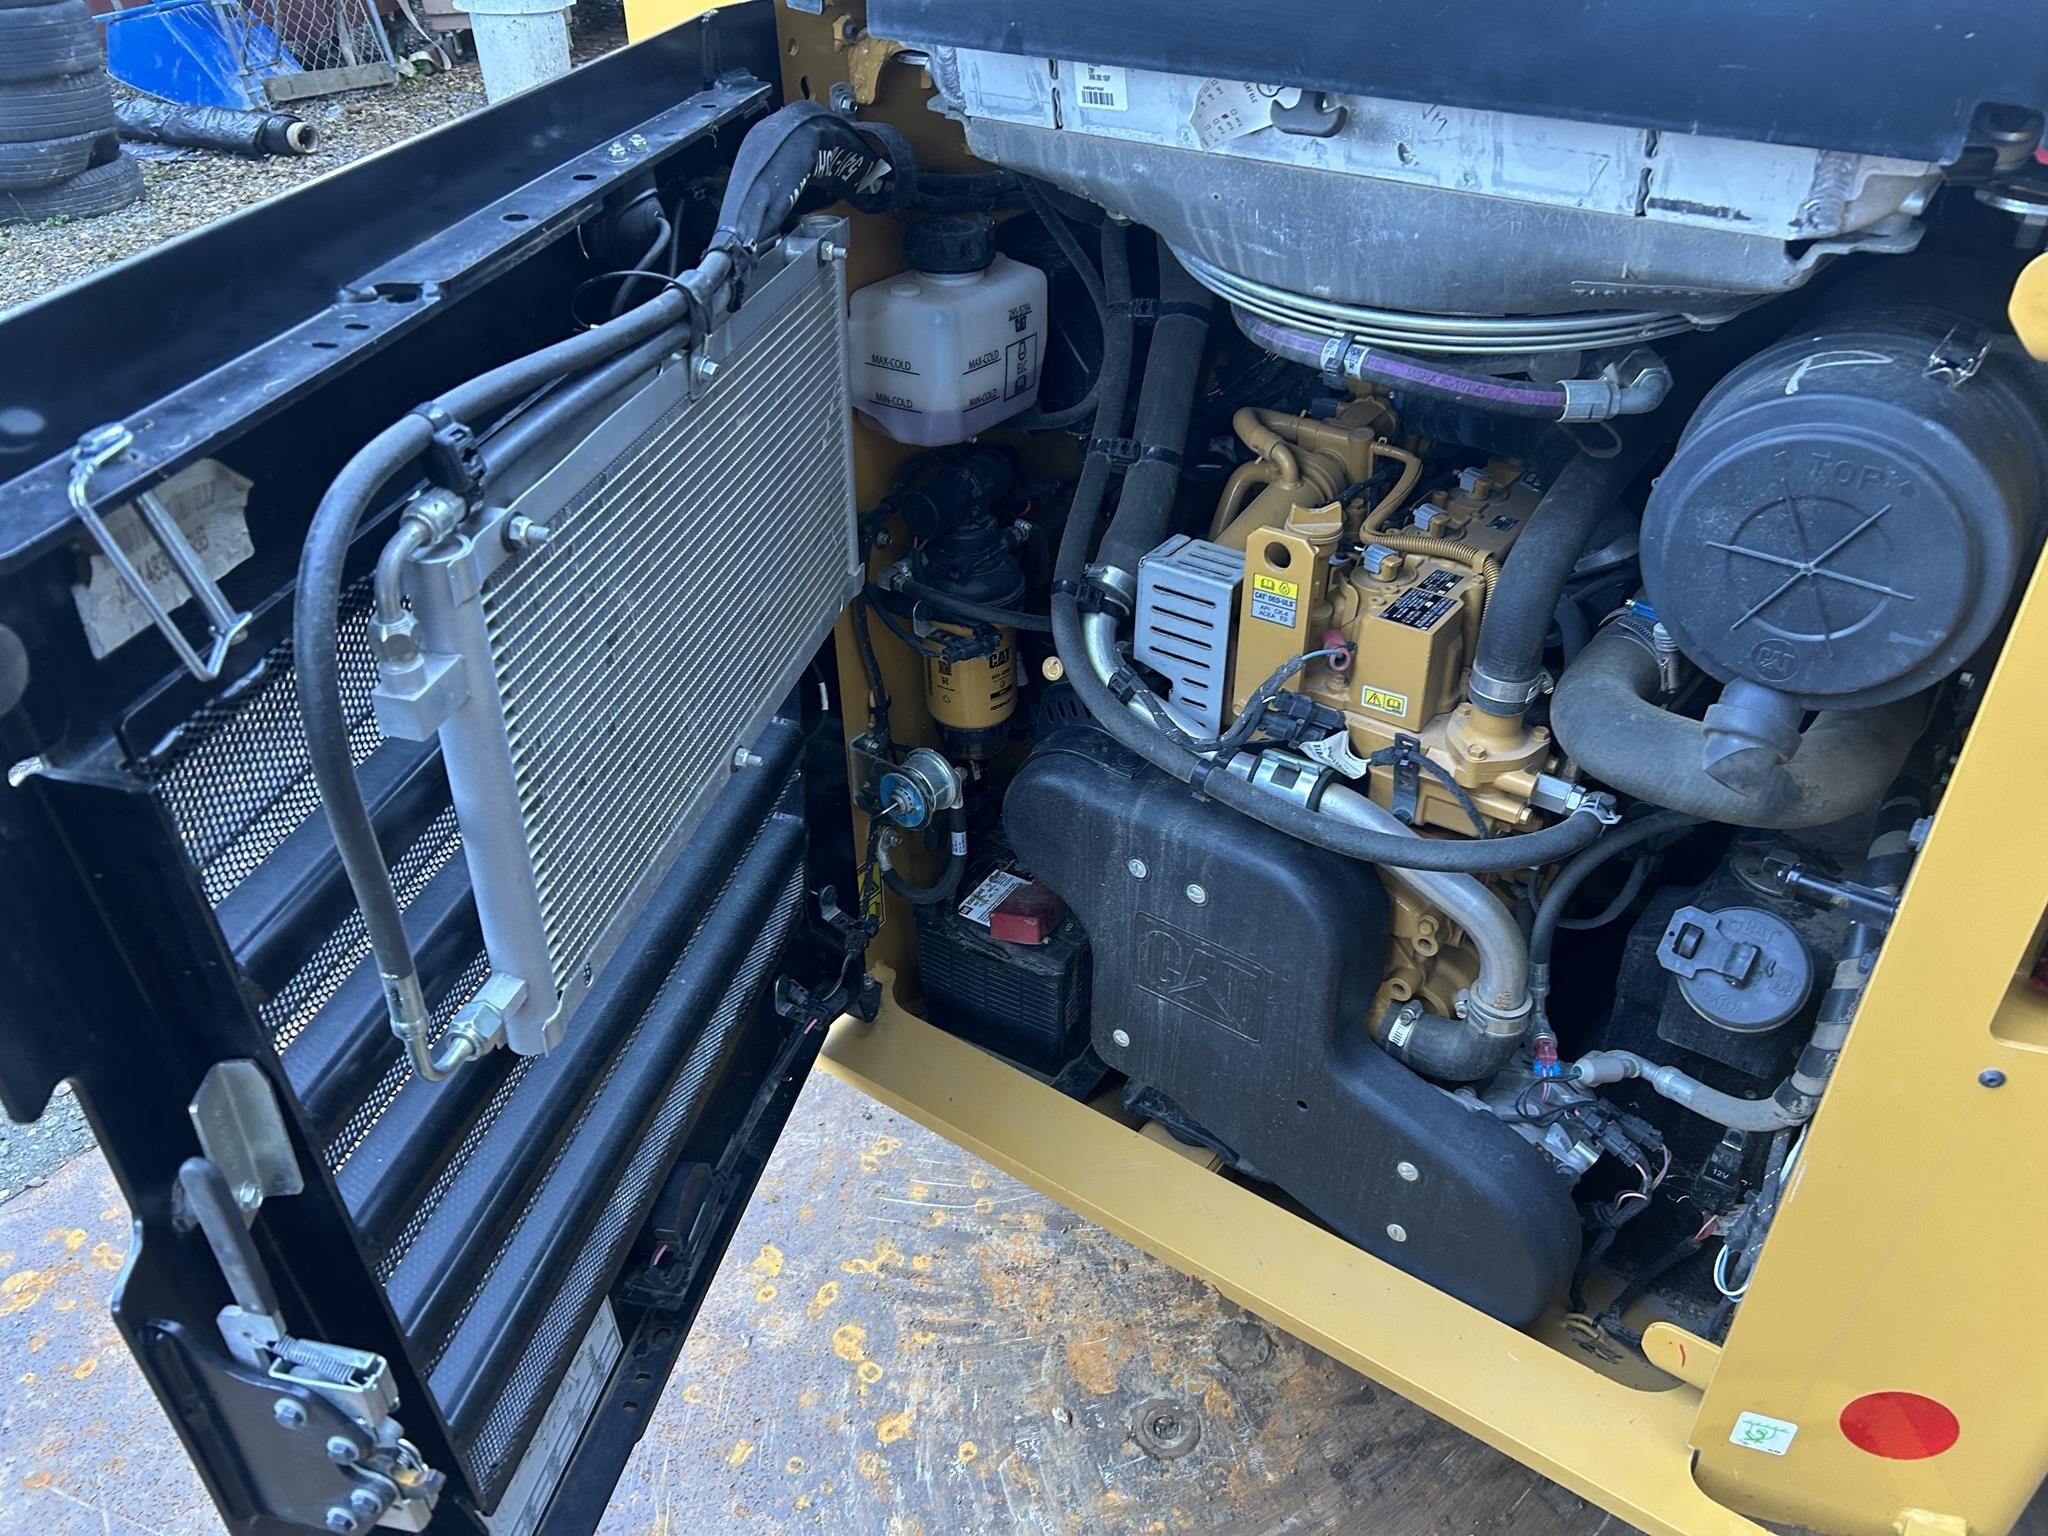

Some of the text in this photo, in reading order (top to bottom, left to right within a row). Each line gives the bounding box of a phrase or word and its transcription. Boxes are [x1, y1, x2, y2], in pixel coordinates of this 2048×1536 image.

[872, 354, 912, 371] MAX-COLD
[968, 349, 1000, 369] MAX-COLD
[876, 392, 913, 409] MIN-COLD
[969, 388, 998, 407] MIN-COLD
[1809, 450, 1883, 491] TOP
[989, 647, 1011, 669] CAT
[1712, 1167, 1730, 1180] 12V
